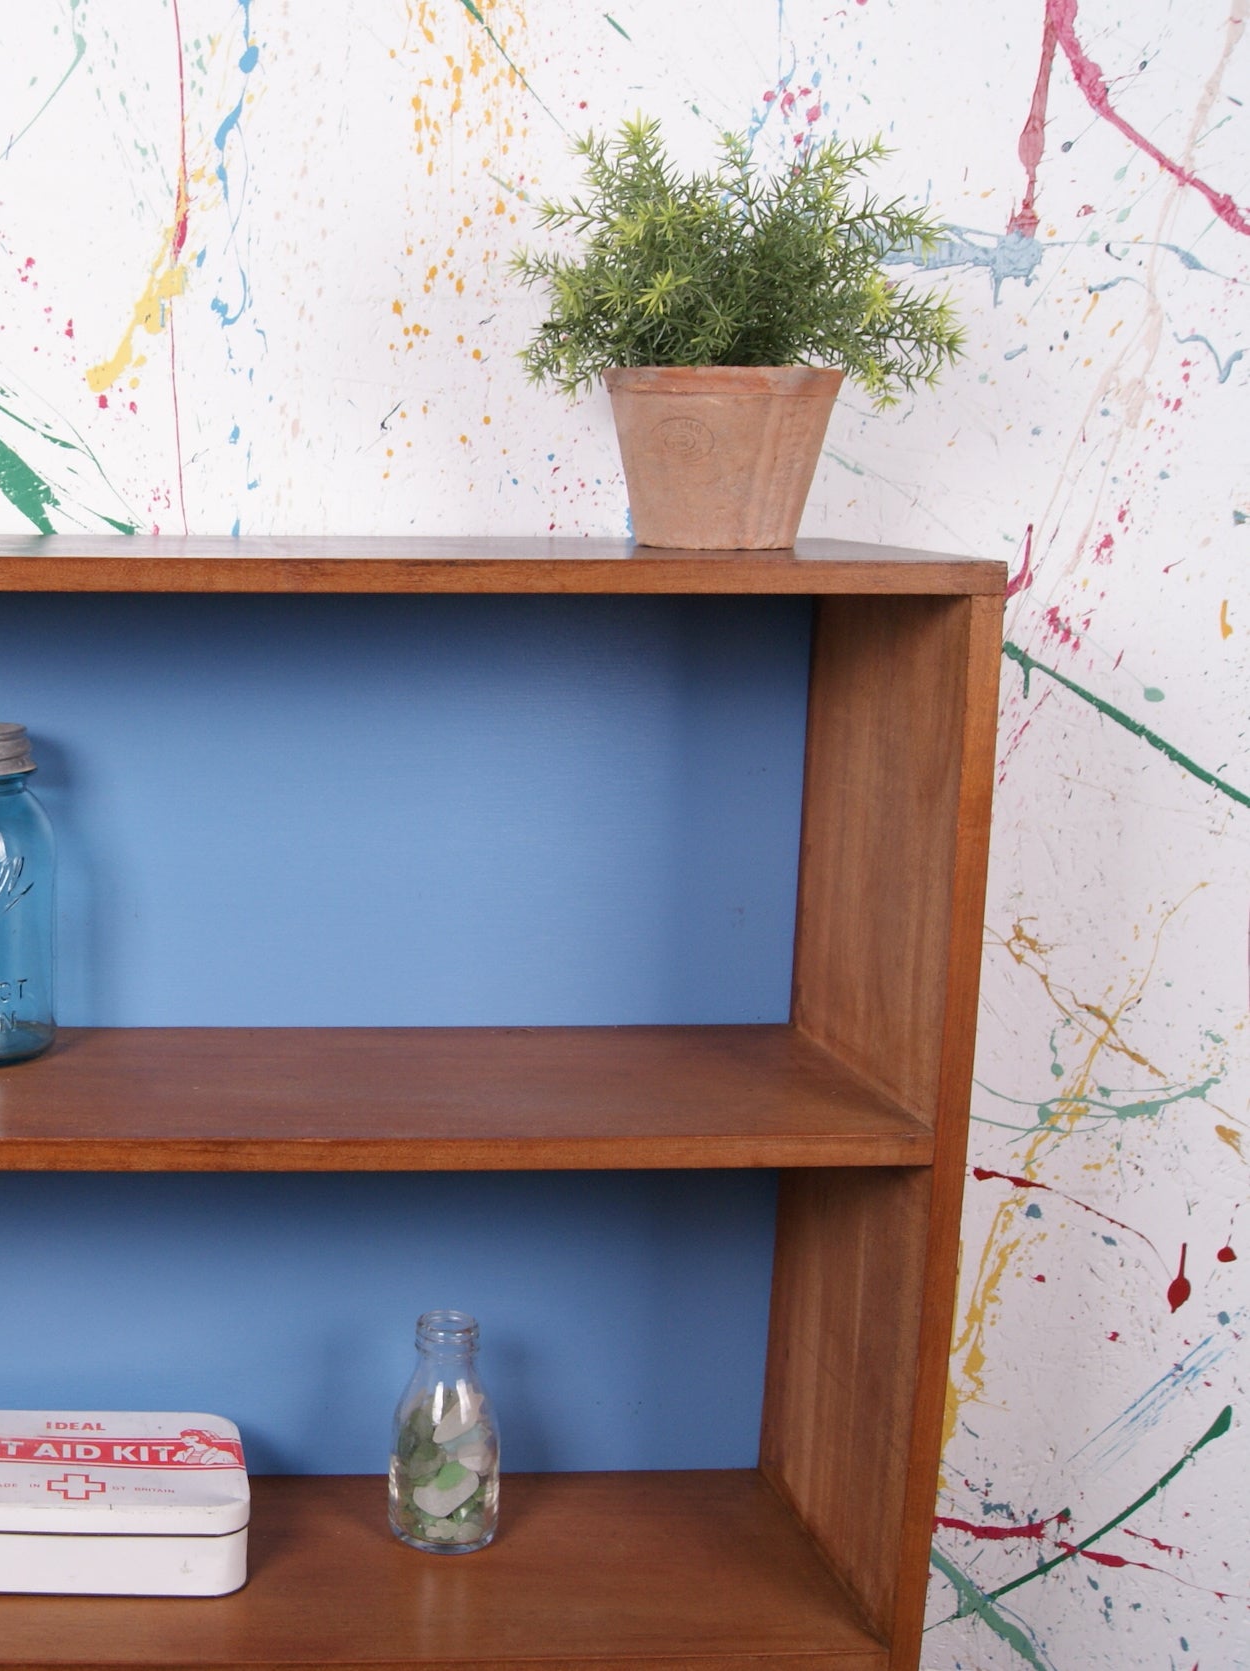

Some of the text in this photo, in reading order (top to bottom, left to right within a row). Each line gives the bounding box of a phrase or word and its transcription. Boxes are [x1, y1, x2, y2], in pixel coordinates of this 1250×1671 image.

[46, 1422, 107, 1431] IDEAL
[33, 1443, 102, 1460] AID
[113, 1445, 175, 1462] KIT
